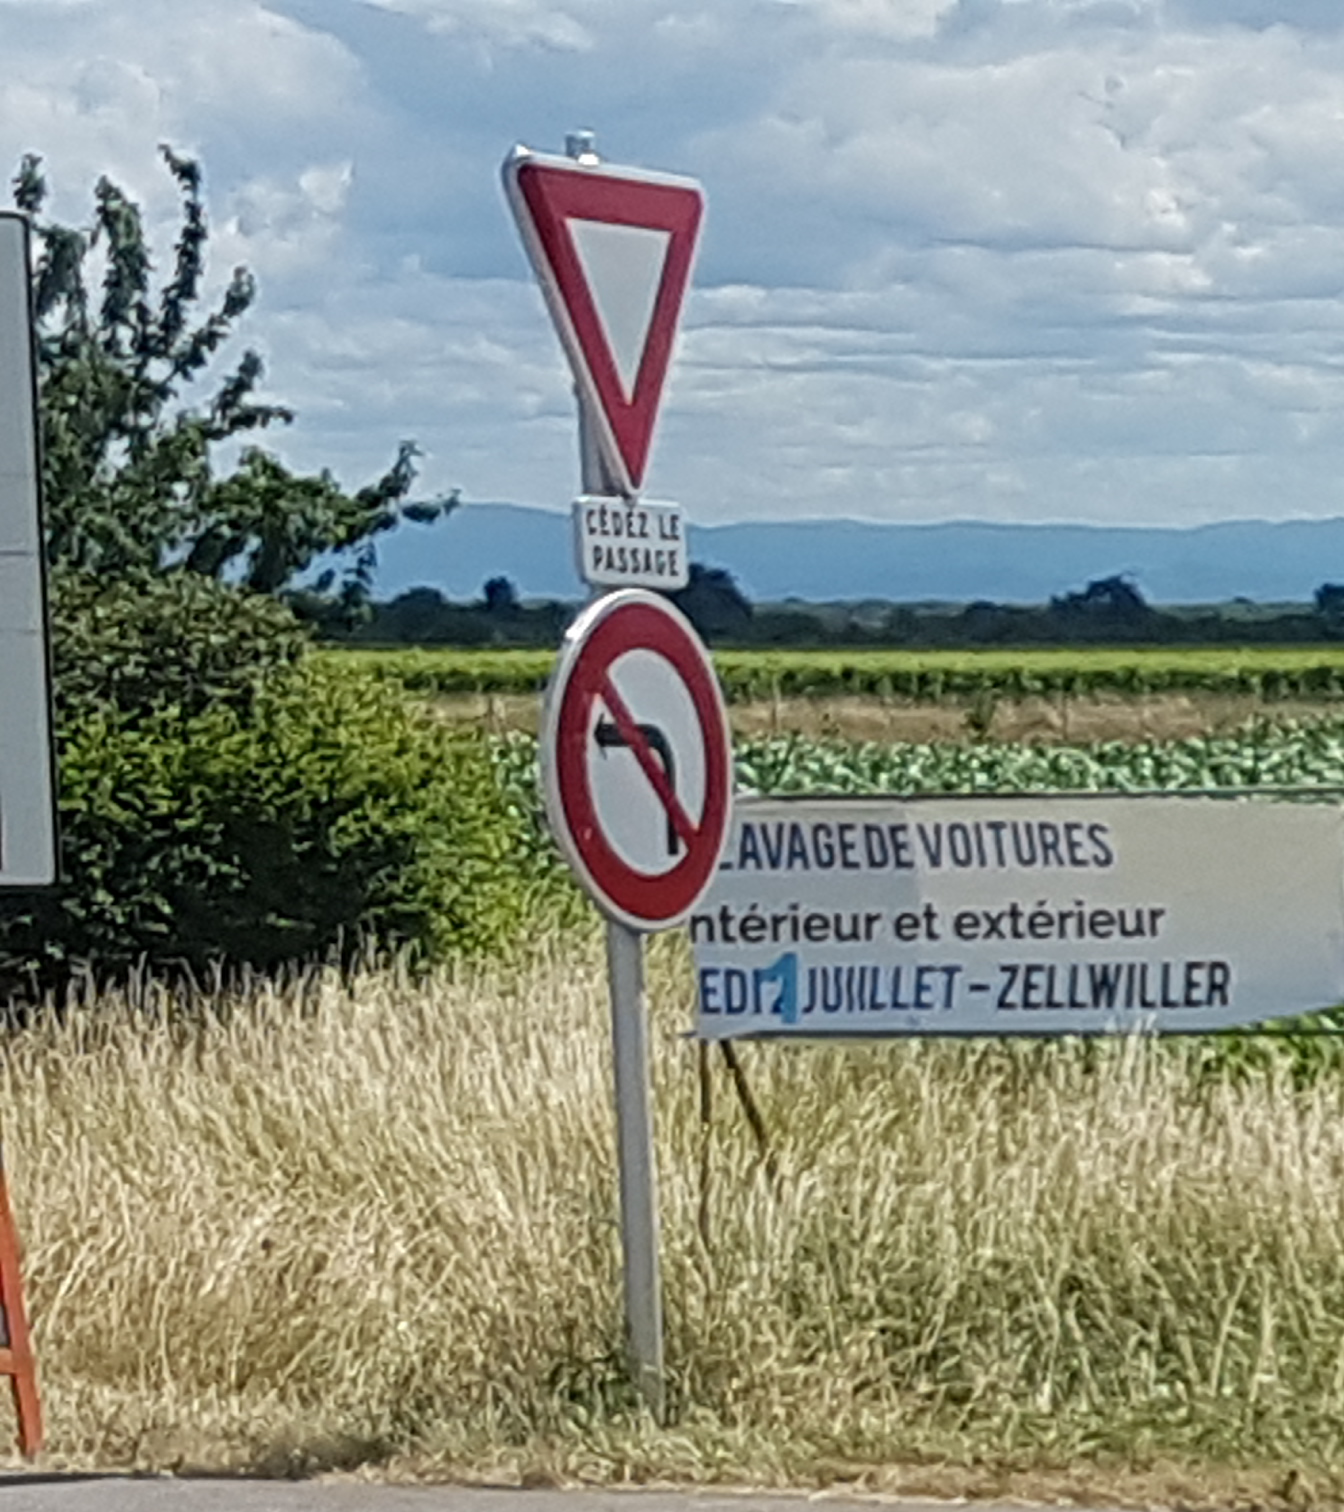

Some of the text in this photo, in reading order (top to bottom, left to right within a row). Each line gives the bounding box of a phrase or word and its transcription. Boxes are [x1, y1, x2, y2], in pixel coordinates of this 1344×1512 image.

[659, 514, 679, 541] LE
[593, 545, 679, 577] PASSAGE
[863, 822, 914, 870] DE
[915, 821, 1114, 868] VOITURES
[690, 898, 1165, 943] ntérieur et extérieur
[700, 966, 761, 1015] EDI
[996, 961, 1231, 1010] ZELLWILLER
